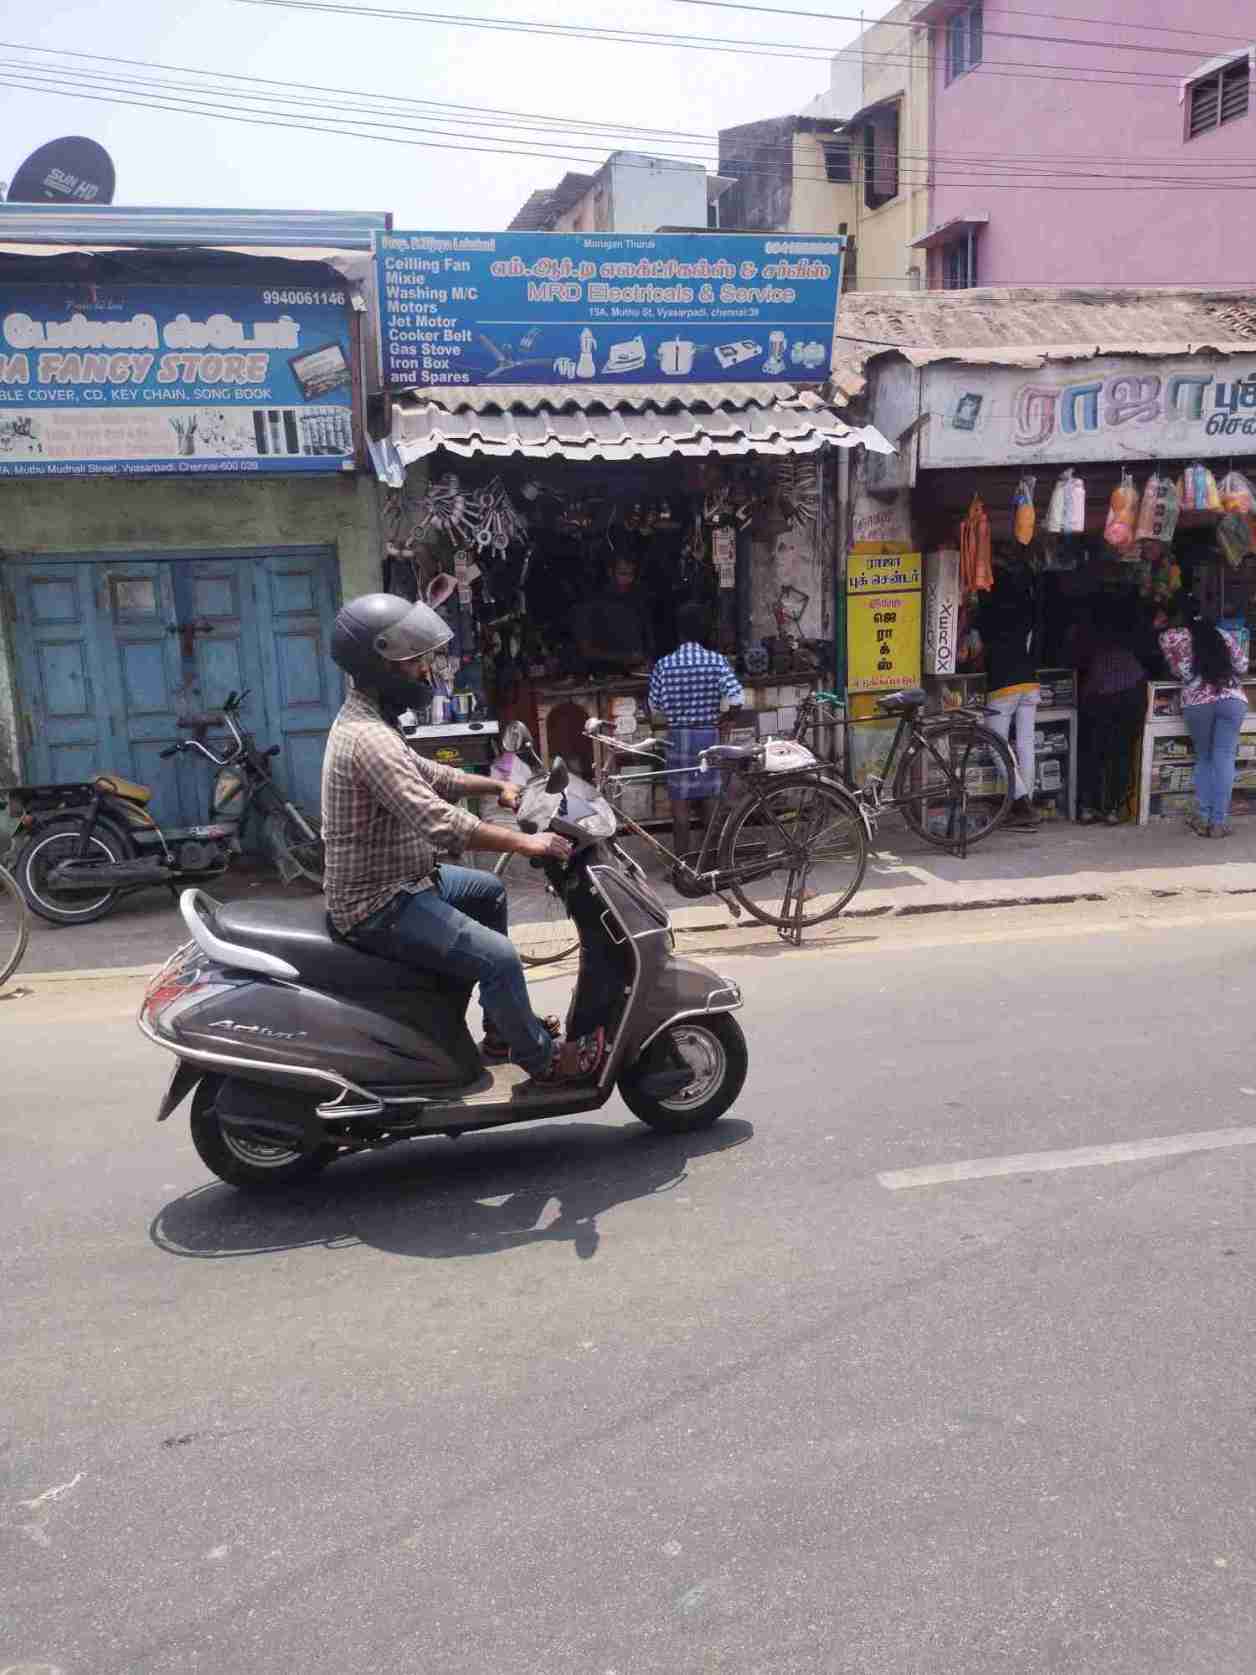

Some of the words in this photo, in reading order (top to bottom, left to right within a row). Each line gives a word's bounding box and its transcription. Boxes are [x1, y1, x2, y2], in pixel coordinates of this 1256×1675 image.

[444, 258, 471, 272] Fan
[740, 261, 757, 279] &
[386, 272, 425, 285] Mixie
[386, 286, 448, 303] Washing
[451, 287, 479, 301] M/C
[528, 282, 582, 302] MRD
[588, 283, 694, 303] Electricals
[698, 284, 715, 303] &
[720, 284, 796, 303] Service
[387, 300, 438, 313] Motors
[387, 314, 411, 328] Jet
[415, 315, 457, 328] Motor
[389, 328, 441, 341] Cooker
[443, 329, 473, 342] Belt
[390, 342, 417, 355] Gas
[421, 342, 462, 356] Stove
[38, 352, 154, 385] FANCY
[157, 352, 270, 386] STORE
[390, 356, 419, 369] Iron
[422, 356, 450, 369] Box
[390, 370, 417, 383] and
[421, 370, 471, 385] Spares
[111, 388, 138, 401] KEY
[194, 388, 231, 400] SONG
[235, 388, 273, 400] BOOK
[936, 604, 953, 672] XEROX
